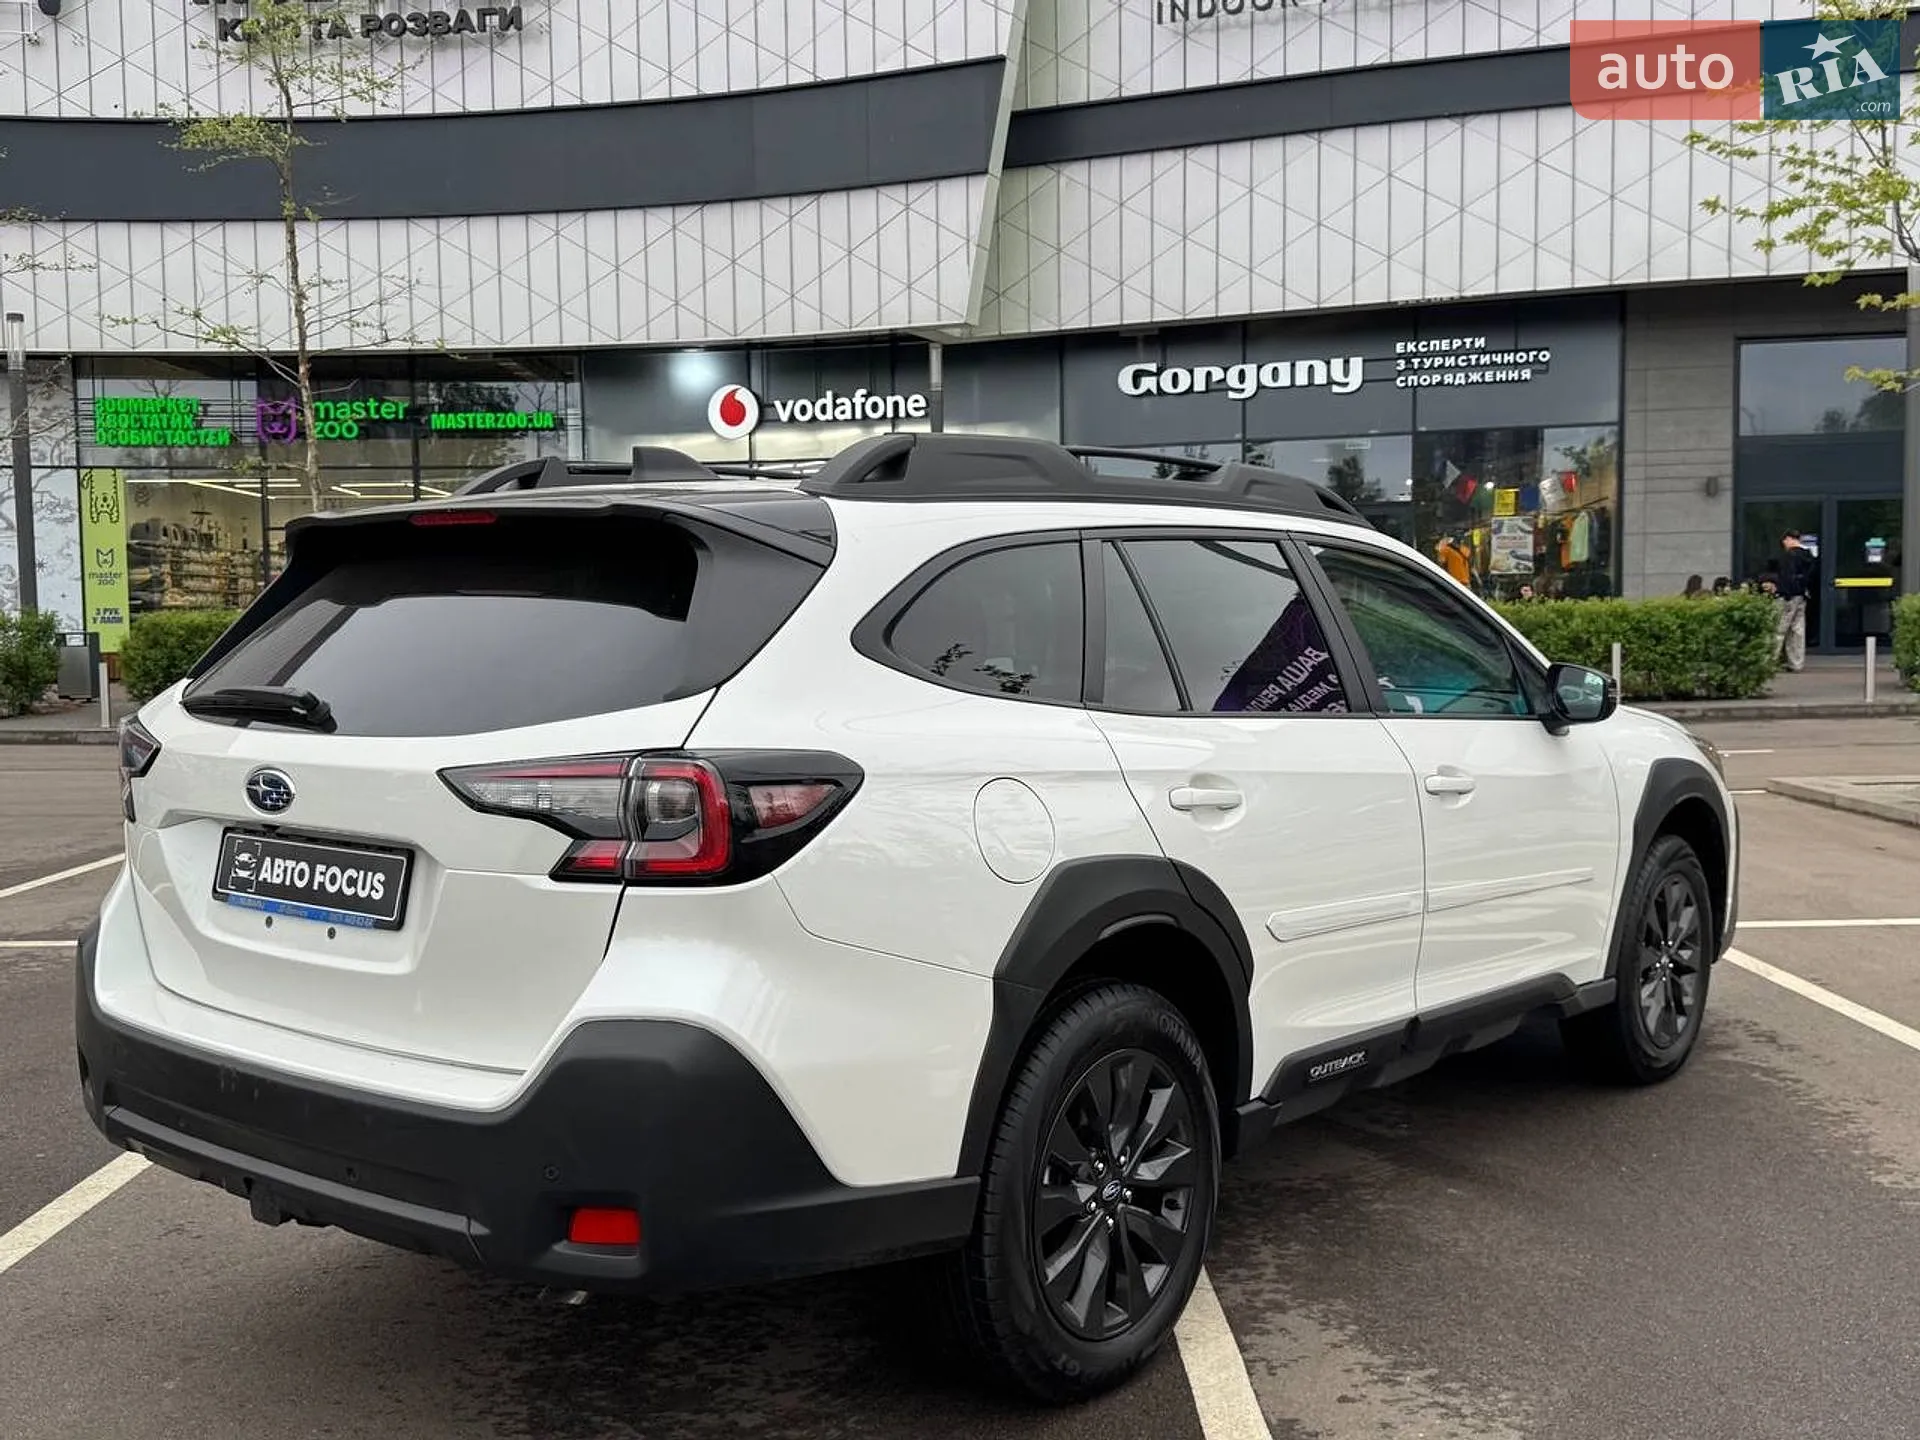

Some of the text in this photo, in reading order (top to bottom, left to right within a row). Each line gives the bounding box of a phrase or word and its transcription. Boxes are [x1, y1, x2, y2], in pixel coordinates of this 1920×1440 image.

[360, 6, 523, 39] РОЗВАГИ
[1396, 336, 1486, 354] ЕКСПЕРТИ
[1411, 349, 1551, 370] ТУРИСТИЧНОГО
[1117, 356, 1364, 400] Gorgany
[1396, 368, 1531, 388] СПОРЯДЖЕННЯ
[313, 398, 410, 421] master
[774, 388, 927, 422] vodafone
[314, 420, 359, 439] zoo
[431, 411, 554, 431] MASTERZOO.UA
[313, 864, 385, 900] FOCUS
[1309, 1051, 1366, 1077] OUTBACK
